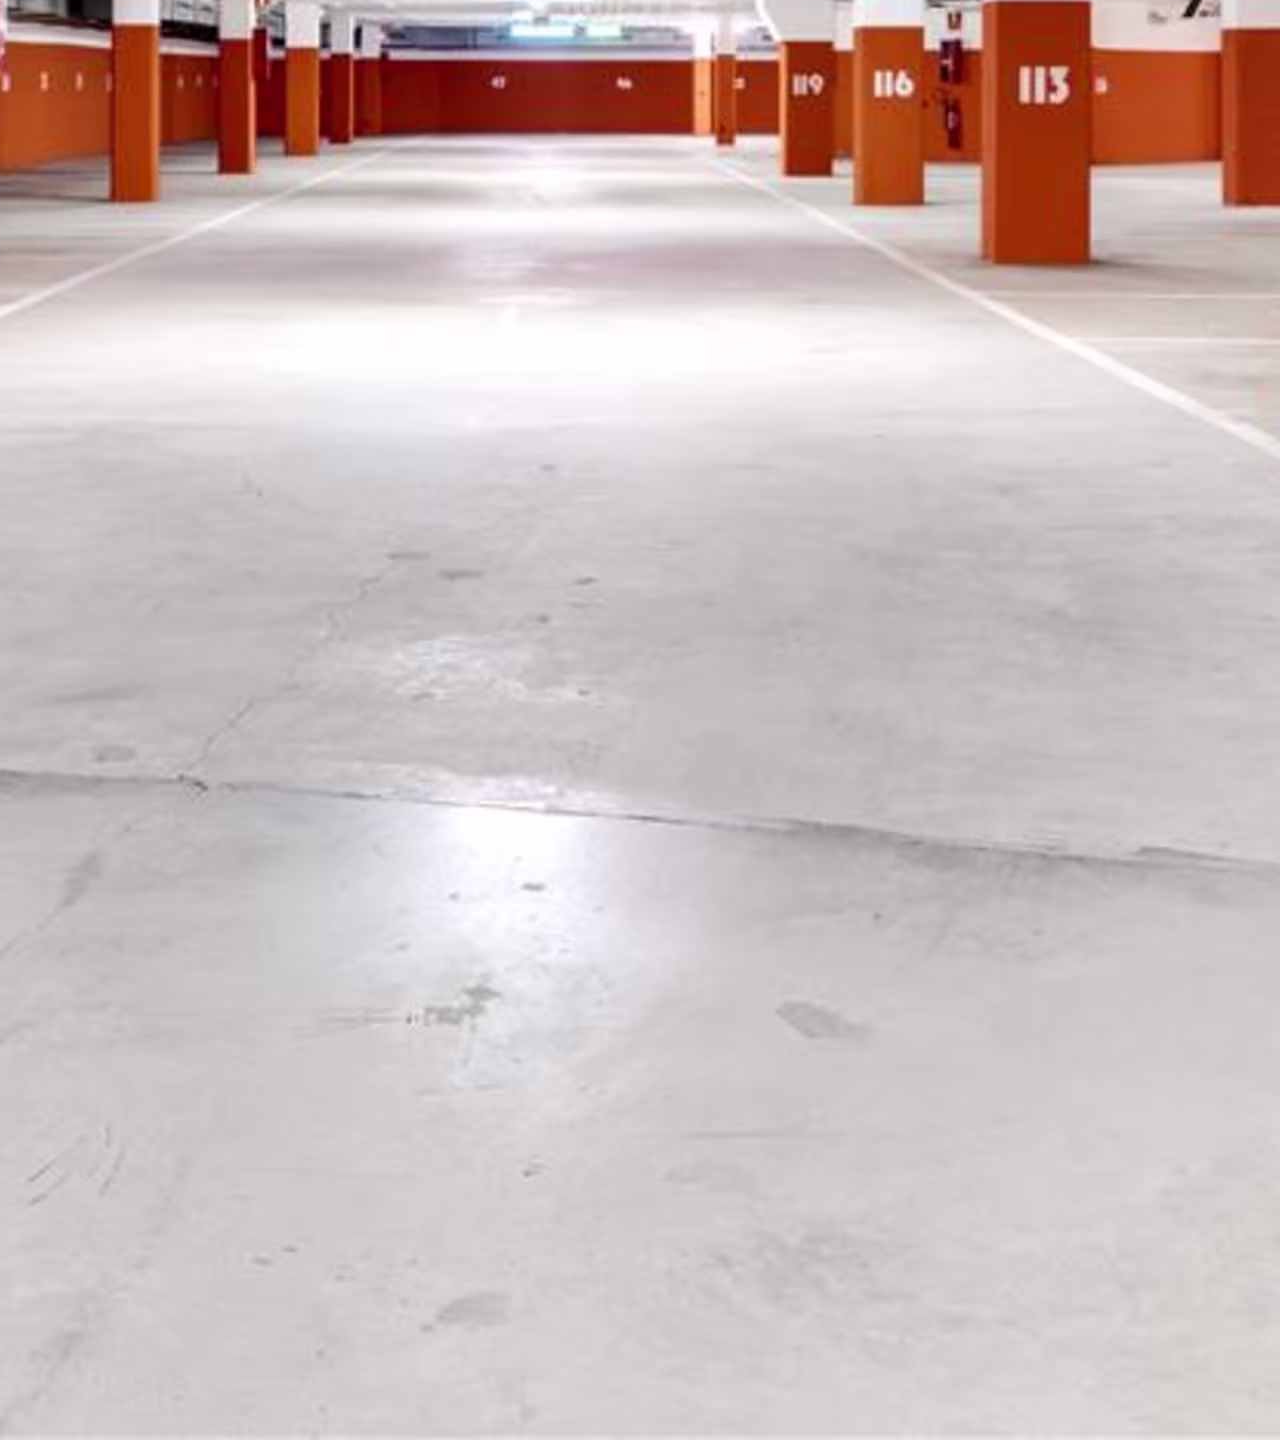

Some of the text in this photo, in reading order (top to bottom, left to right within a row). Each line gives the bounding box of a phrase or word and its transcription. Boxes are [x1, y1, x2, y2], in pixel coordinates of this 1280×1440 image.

[792, 74, 824, 96] 119
[874, 70, 914, 98] 116
[1019, 65, 1070, 104] 113
